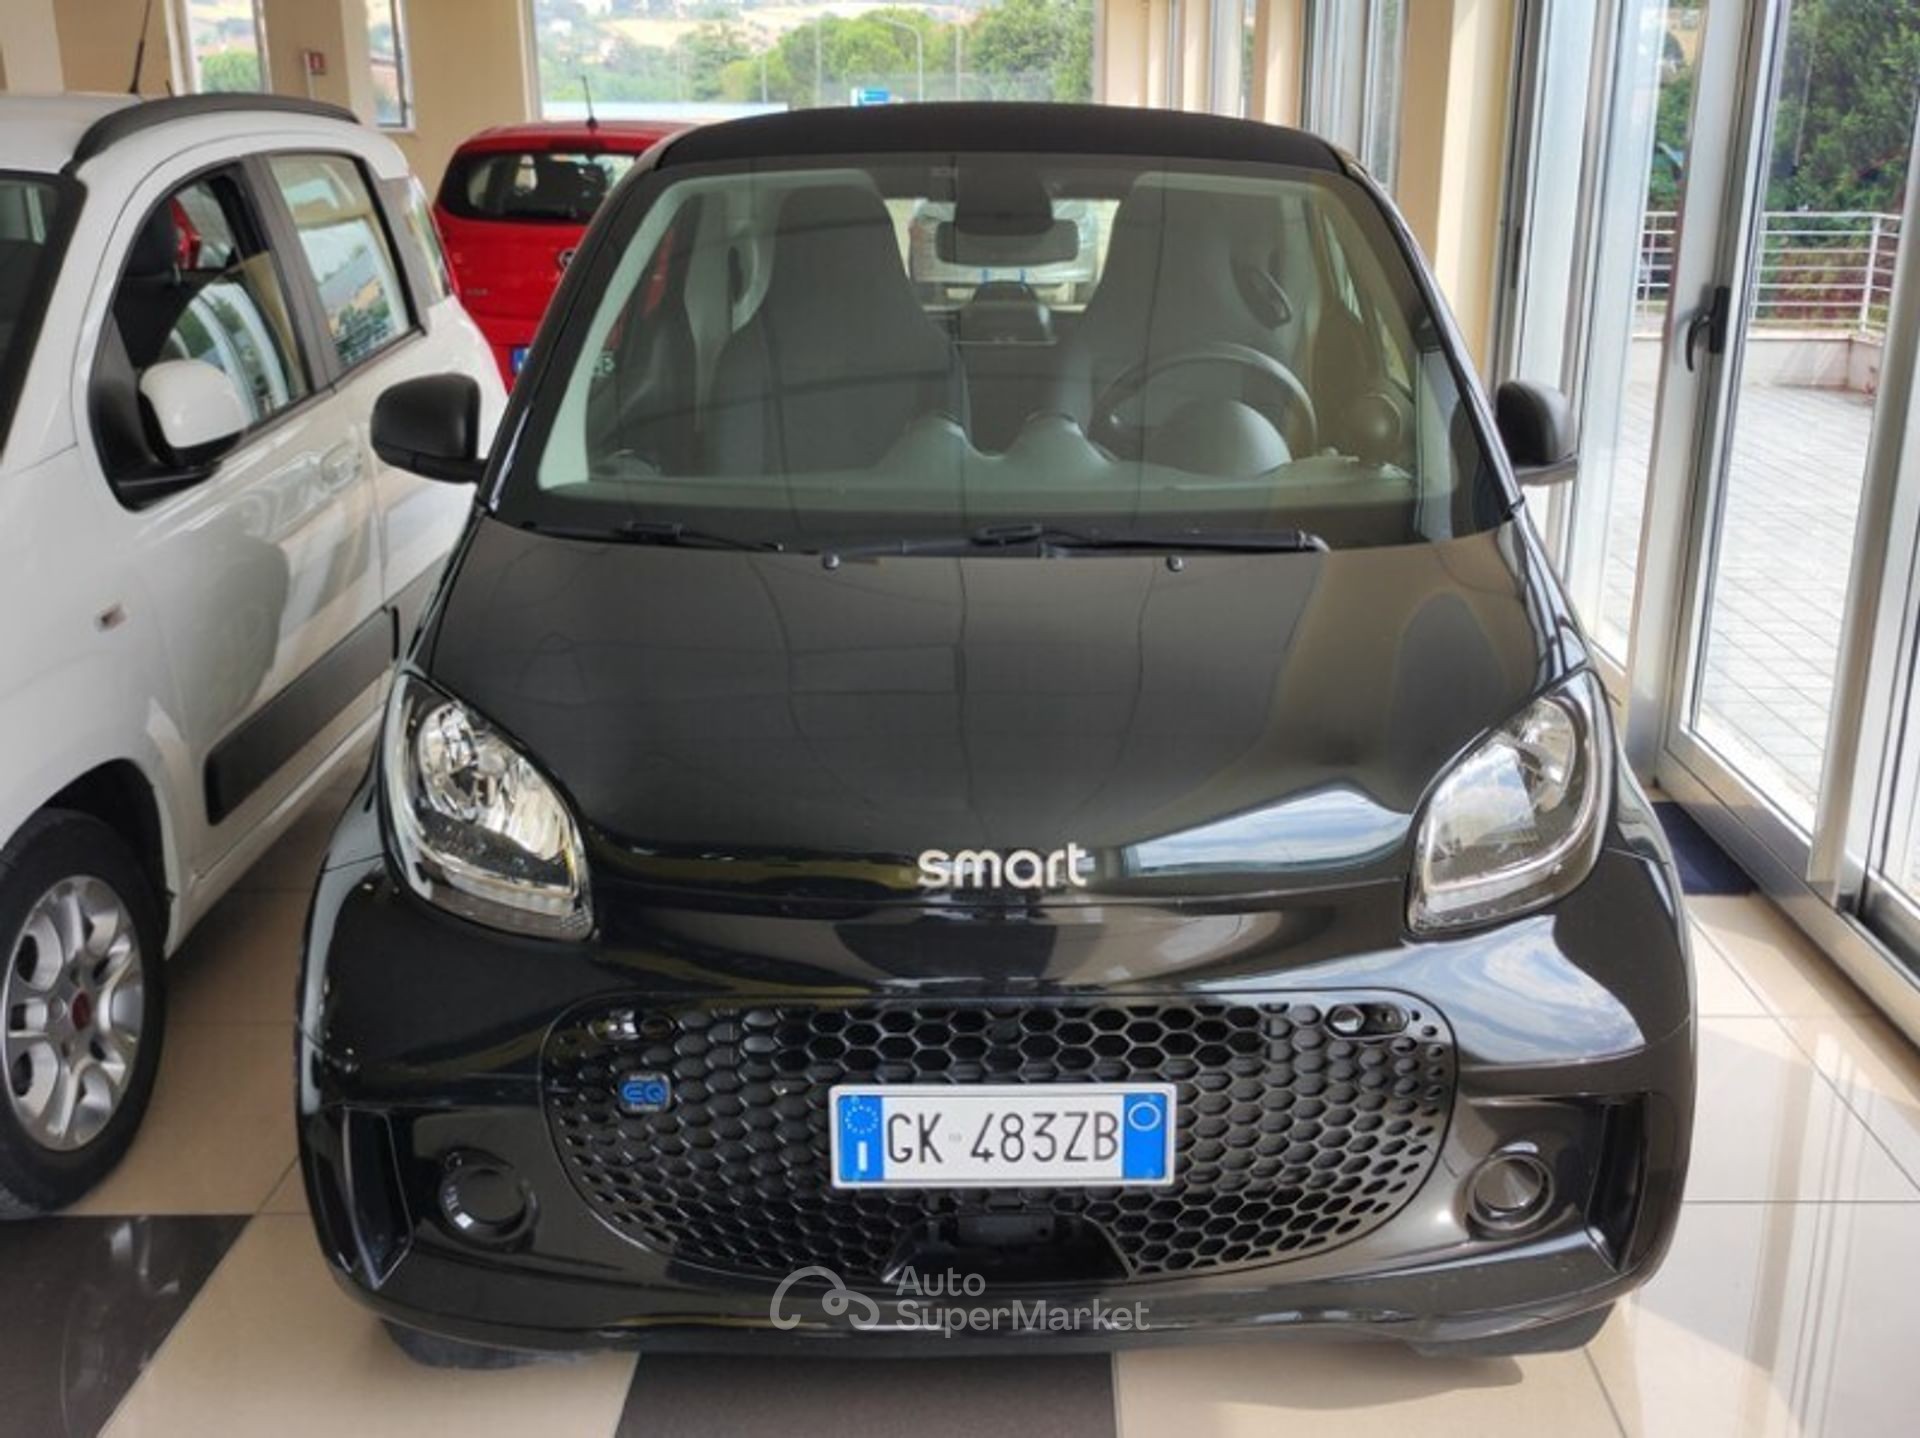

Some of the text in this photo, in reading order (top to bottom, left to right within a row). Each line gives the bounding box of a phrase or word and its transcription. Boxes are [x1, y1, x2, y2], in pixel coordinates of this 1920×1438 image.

[917, 842, 1088, 888] smart
[623, 1081, 666, 1103] EQ
[886, 1111, 1120, 1164] GK 483ZB
